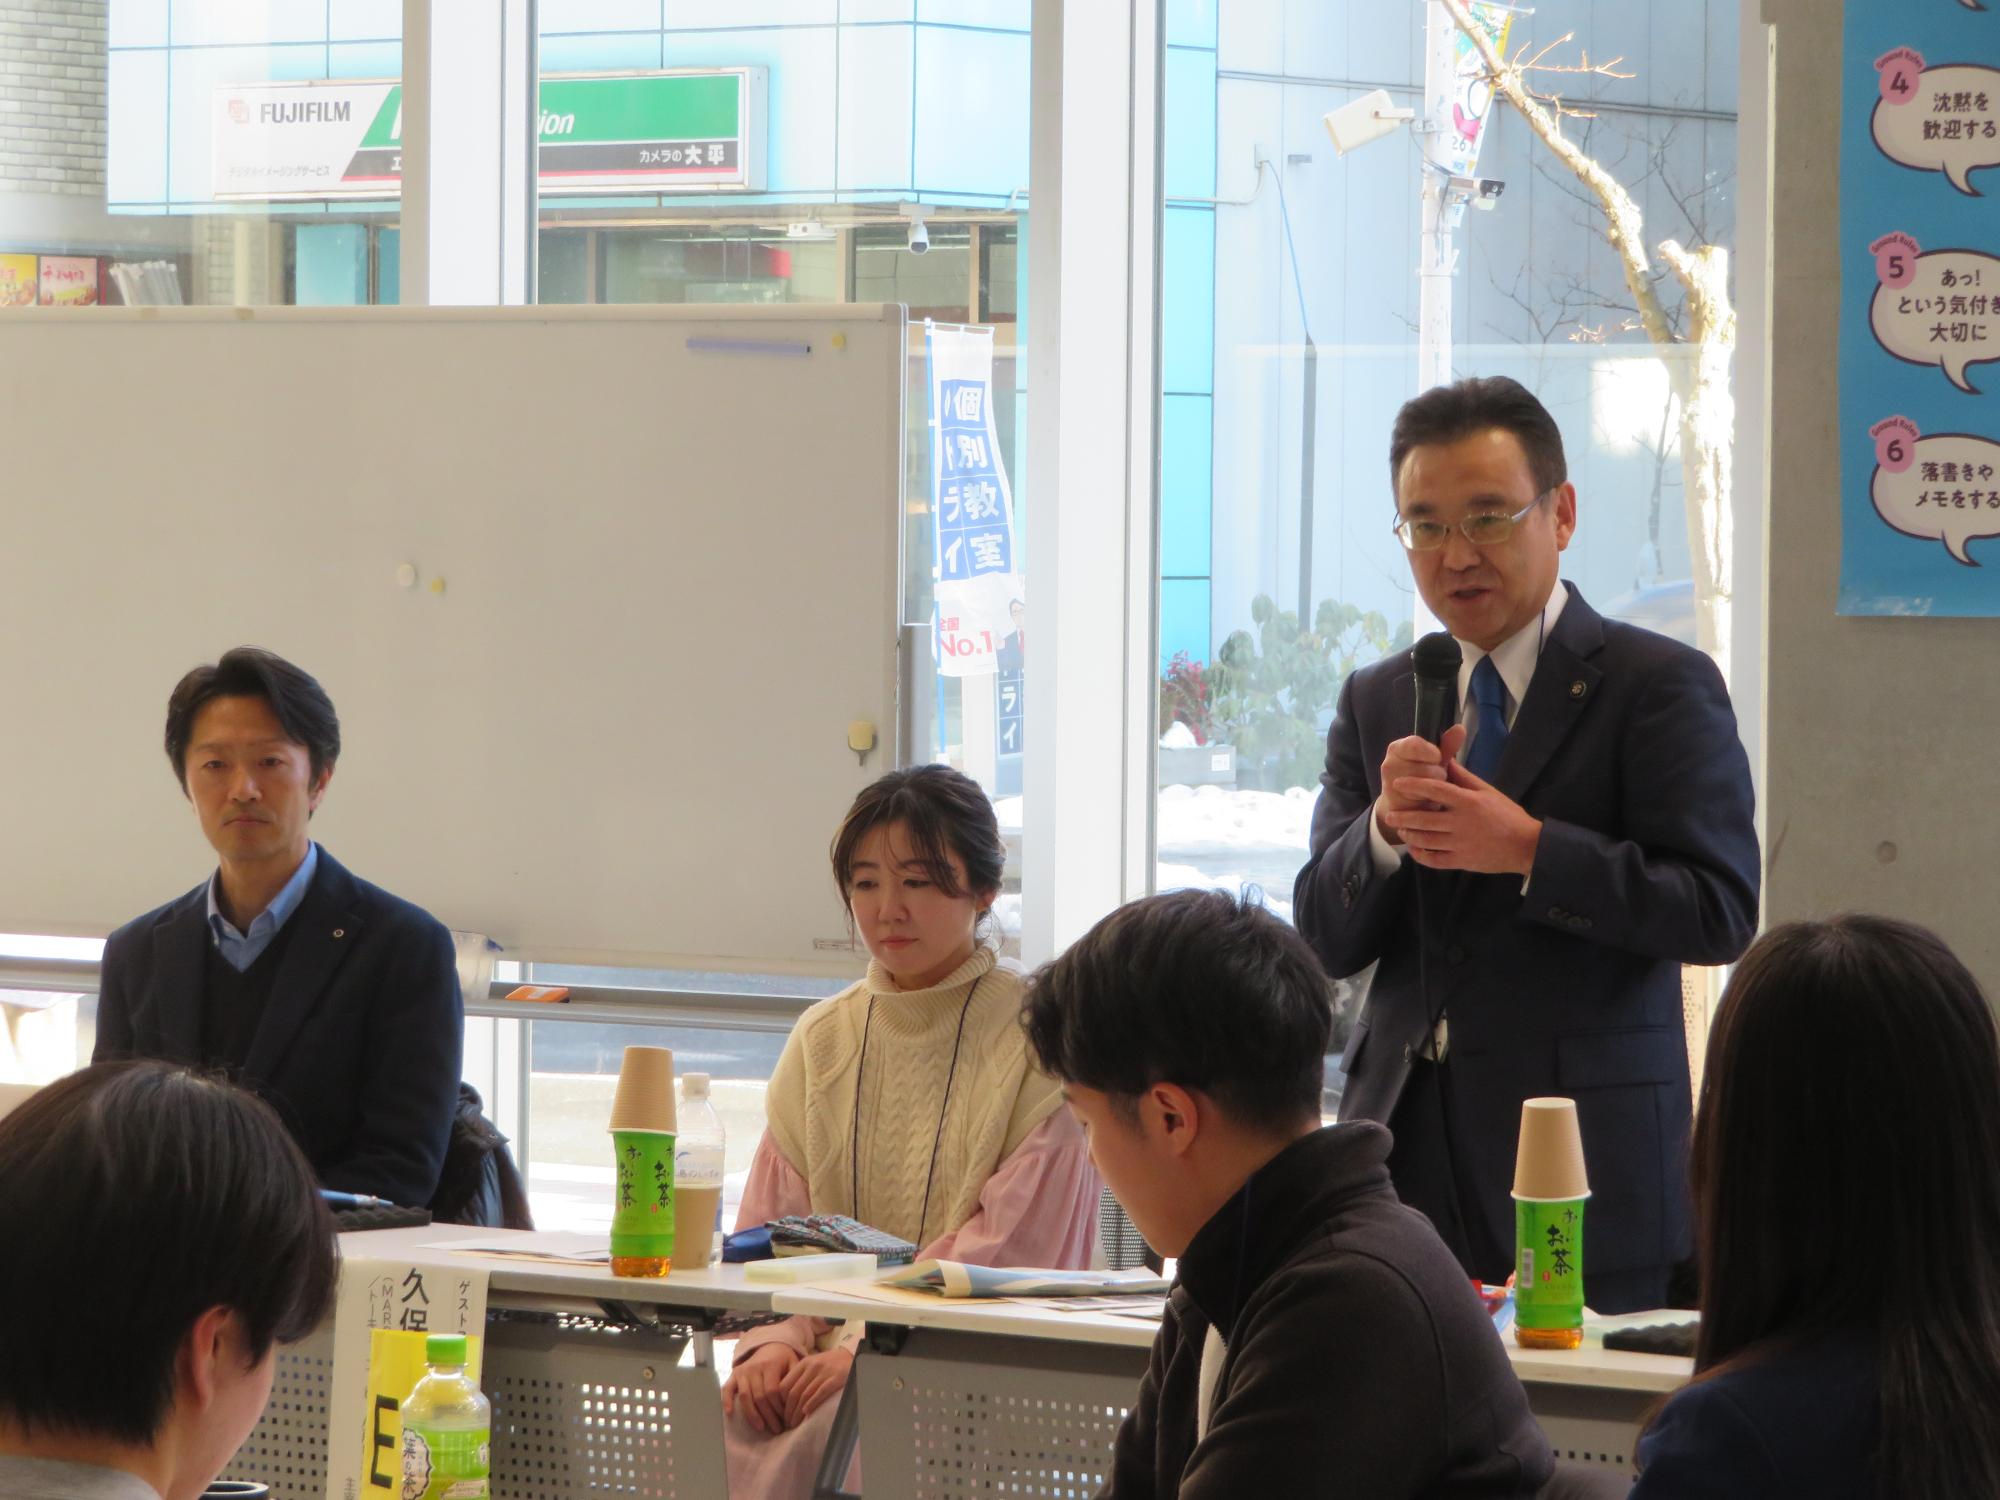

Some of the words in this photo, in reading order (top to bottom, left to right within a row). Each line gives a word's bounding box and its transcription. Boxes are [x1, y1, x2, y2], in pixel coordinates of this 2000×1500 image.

[1889, 71, 1909, 94] 4
[259, 101, 351, 124] FUJIFILM
[1932, 92, 1989, 113] 沈黙を
[538, 109, 575, 135] ion
[1922, 119, 1998, 141] 歓迎する
[1888, 255, 1905, 279] 5
[1929, 322, 1988, 343] 大切に
[1887, 438, 1904, 462] 6
[954, 386, 1005, 571] 個別教室
[1920, 461, 1994, 482] 落書きや
[1915, 489, 2000, 509] メモをする
[1546, 1223, 1574, 1277] お茶
[458, 1280, 472, 1335] ゲスト
[370, 1394, 399, 1489] E
